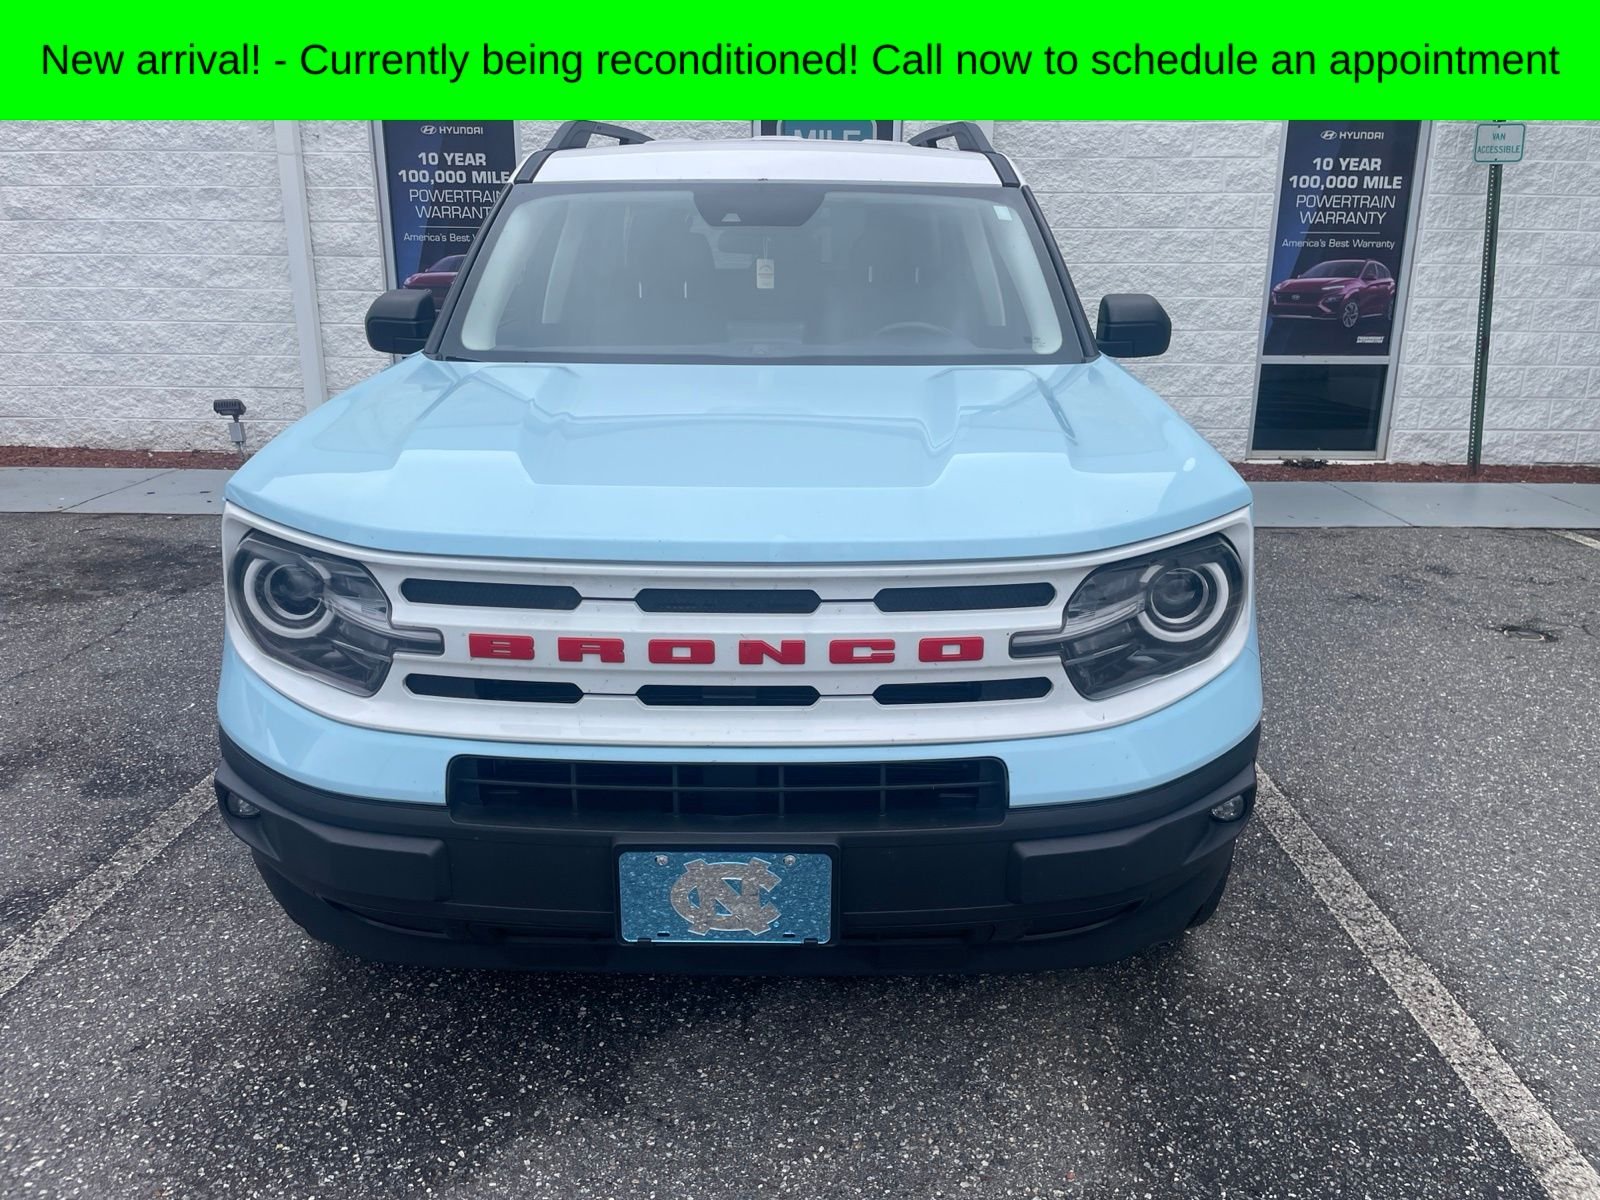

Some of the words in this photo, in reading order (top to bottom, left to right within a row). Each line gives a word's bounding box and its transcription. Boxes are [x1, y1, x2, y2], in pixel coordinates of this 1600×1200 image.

[439, 126, 484, 135] HYUNDAI
[1339, 131, 1385, 140] HYUNDAI
[1492, 133, 1506, 141] VAN
[1477, 145, 1521, 154] ACCESSIBLE
[417, 152, 439, 166] 10
[443, 152, 487, 166] YEAR
[1312, 157, 1334, 171] 10
[1339, 157, 1382, 171] YEAR
[398, 169, 467, 185] 100,000
[471, 170, 510, 184] MILE
[1289, 175, 1358, 191] 100,000
[1363, 175, 1403, 189] MILE
[1295, 194, 1396, 209] POWERTRAIN
[415, 205, 492, 219] WARRANT
[1299, 211, 1387, 225] WARRANTY
[403, 232, 447, 242] America's
[449, 233, 471, 243] Best
[1281, 239, 1326, 248] America's
[1328, 239, 1350, 248] Best
[1352, 239, 1396, 251] Warranty
[468, 633, 985, 665] BRONCO
